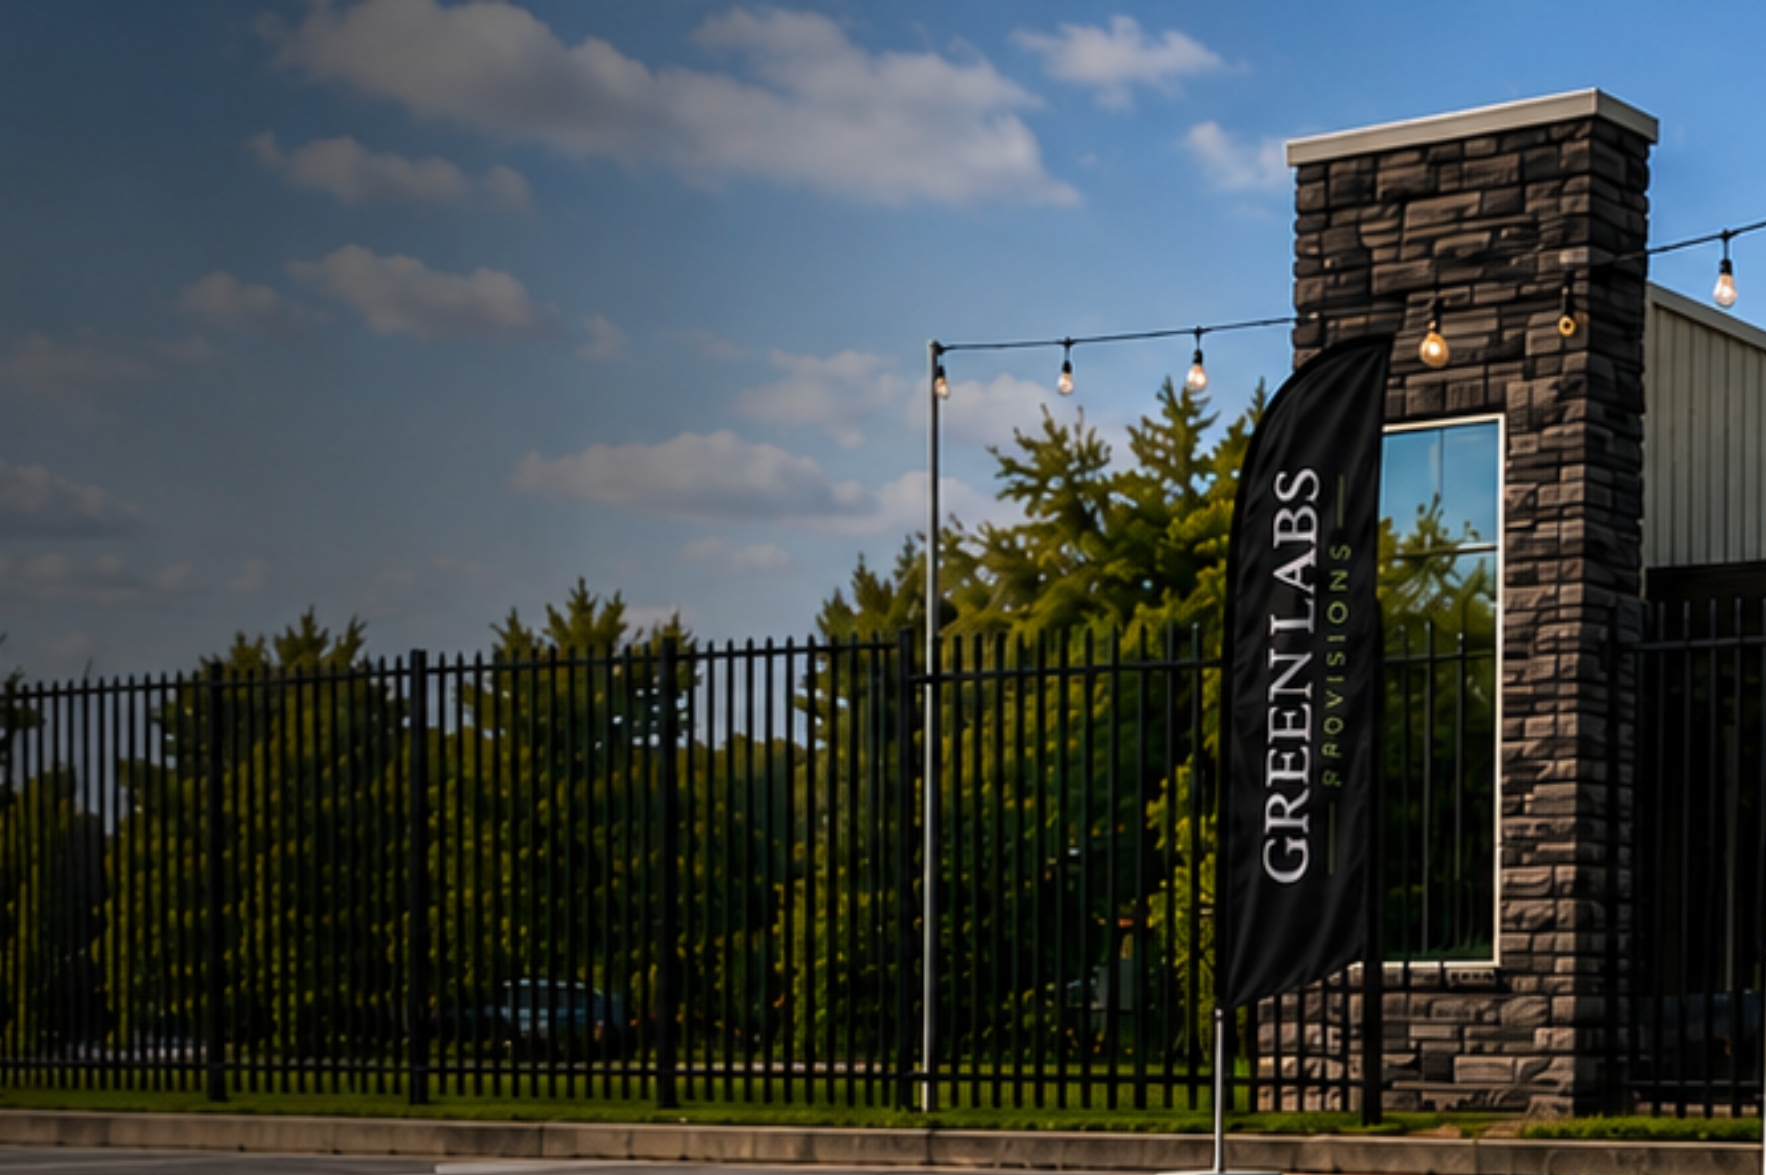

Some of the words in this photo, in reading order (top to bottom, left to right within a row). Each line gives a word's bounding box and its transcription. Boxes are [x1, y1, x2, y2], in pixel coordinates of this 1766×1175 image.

[1268, 467, 1320, 636] LABS
[1320, 544, 1352, 788] PROVISIONS
[1262, 647, 1314, 884] GREEN
